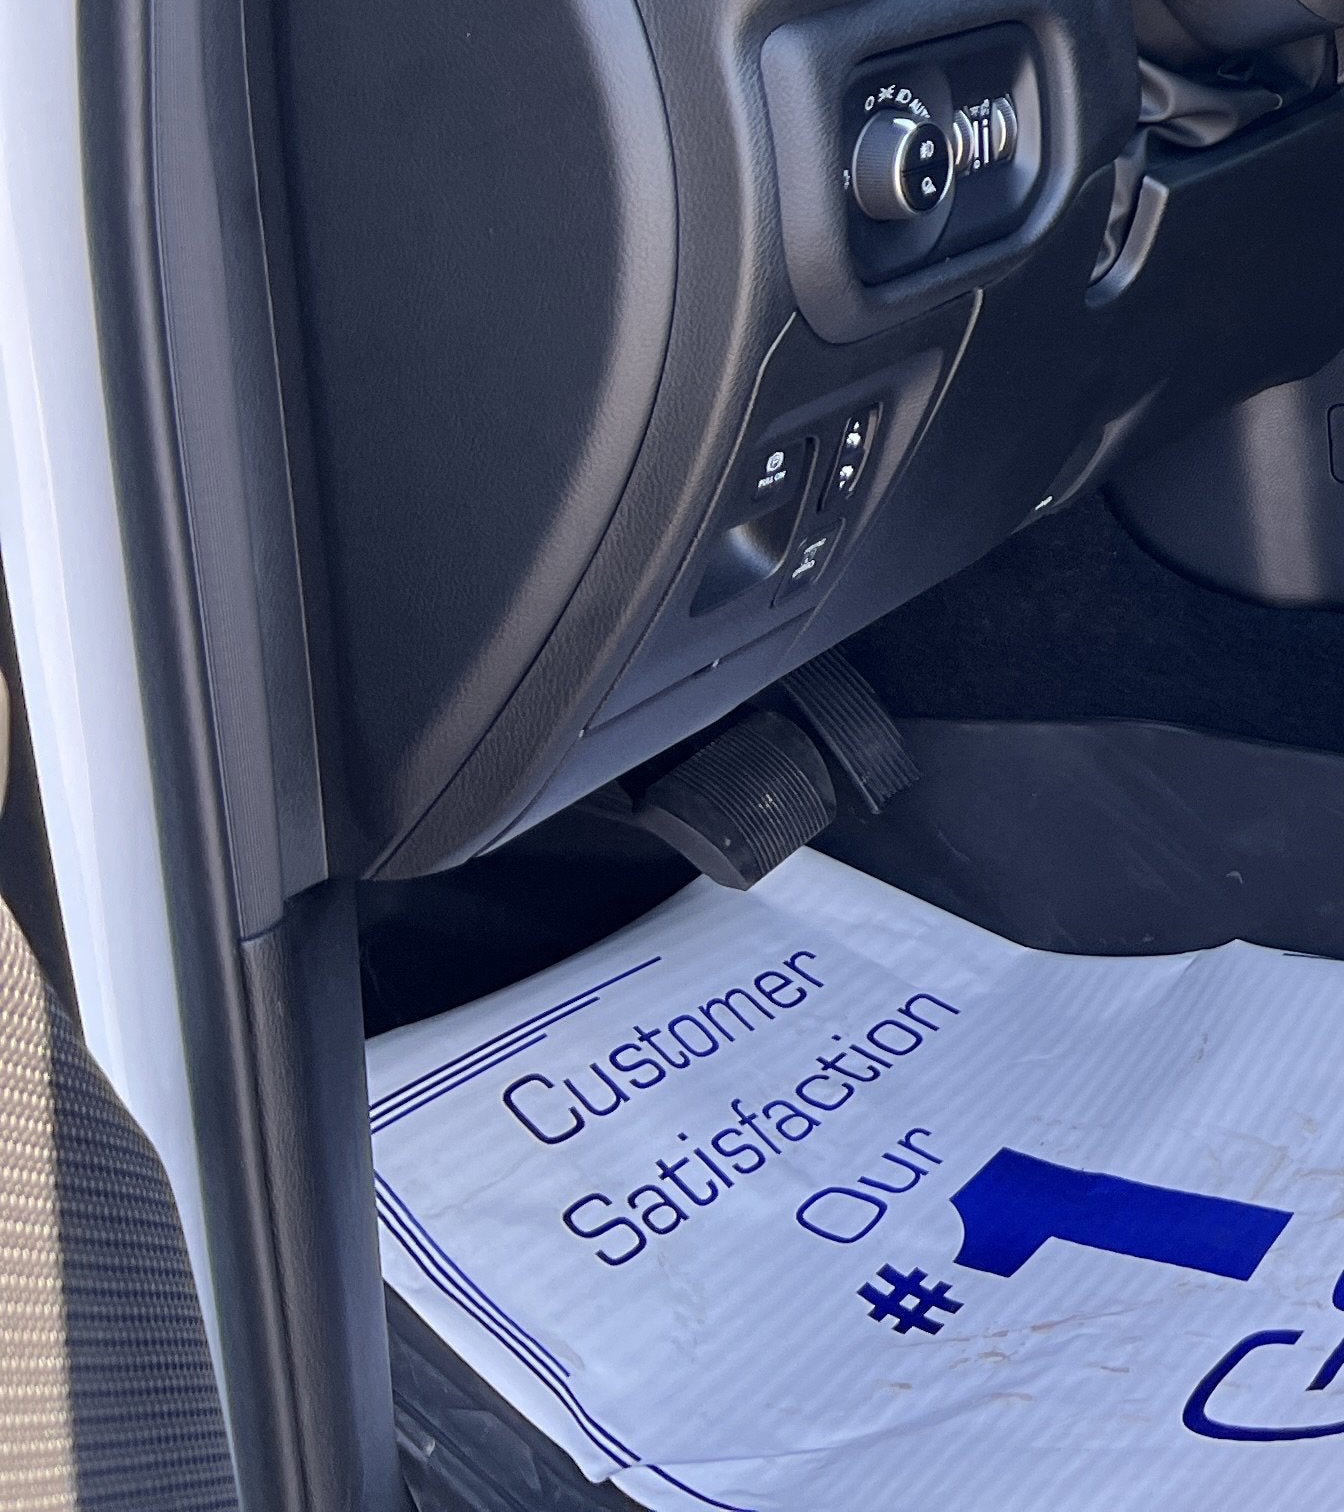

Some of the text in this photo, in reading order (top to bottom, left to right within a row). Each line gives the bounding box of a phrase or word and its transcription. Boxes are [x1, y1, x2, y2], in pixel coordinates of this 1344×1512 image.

[503, 949, 826, 1146] Customer
[564, 991, 963, 1268] Satisfaction
[795, 1126, 944, 1245] Our
[857, 1147, 1294, 1336] #1
